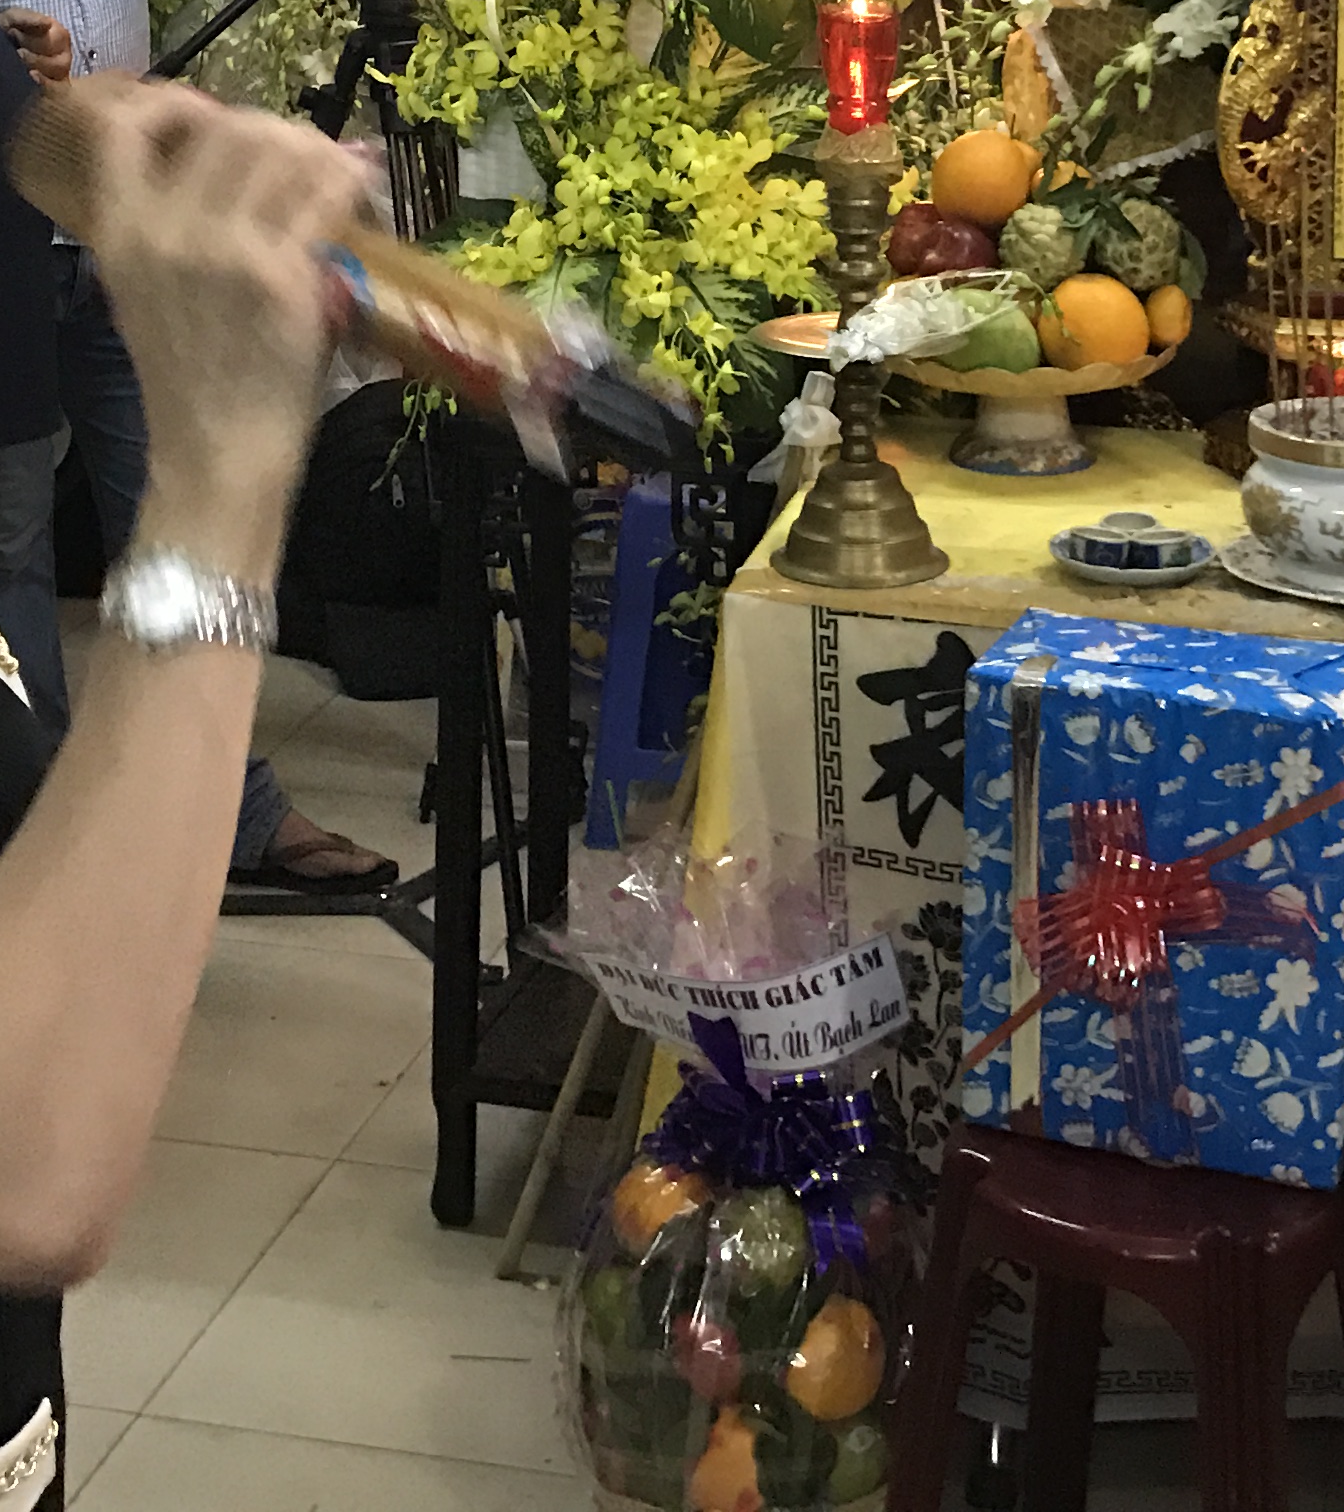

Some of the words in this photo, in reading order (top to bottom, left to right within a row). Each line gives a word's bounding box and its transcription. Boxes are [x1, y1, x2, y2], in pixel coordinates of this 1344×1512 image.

[765, 974, 825, 1009] GIÁC
[829, 947, 884, 986] TÂM
[869, 998, 901, 1027] Lan
